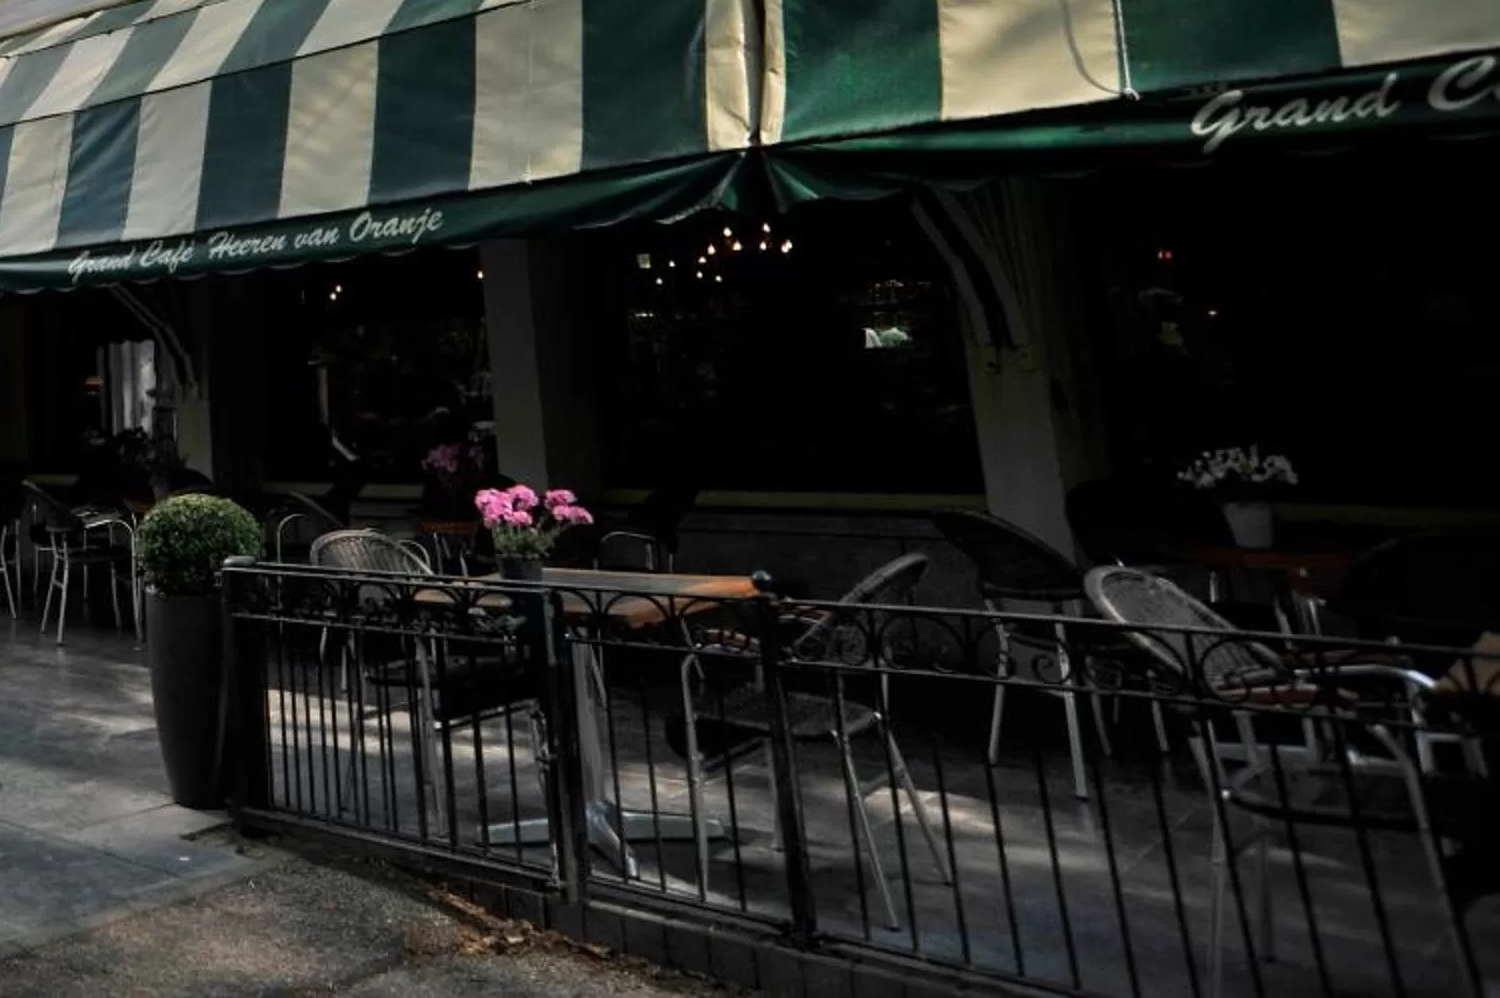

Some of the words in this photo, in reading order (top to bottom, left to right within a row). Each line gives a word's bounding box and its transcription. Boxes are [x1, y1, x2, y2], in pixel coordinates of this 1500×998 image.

[1190, 72, 1398, 153] Grand
[1428, 55, 1500, 112] C
[68, 248, 138, 286] Grand
[140, 237, 196, 274] Café
[207, 230, 289, 261] Heeren
[295, 223, 341, 249] van
[349, 206, 445, 244] Oranje
